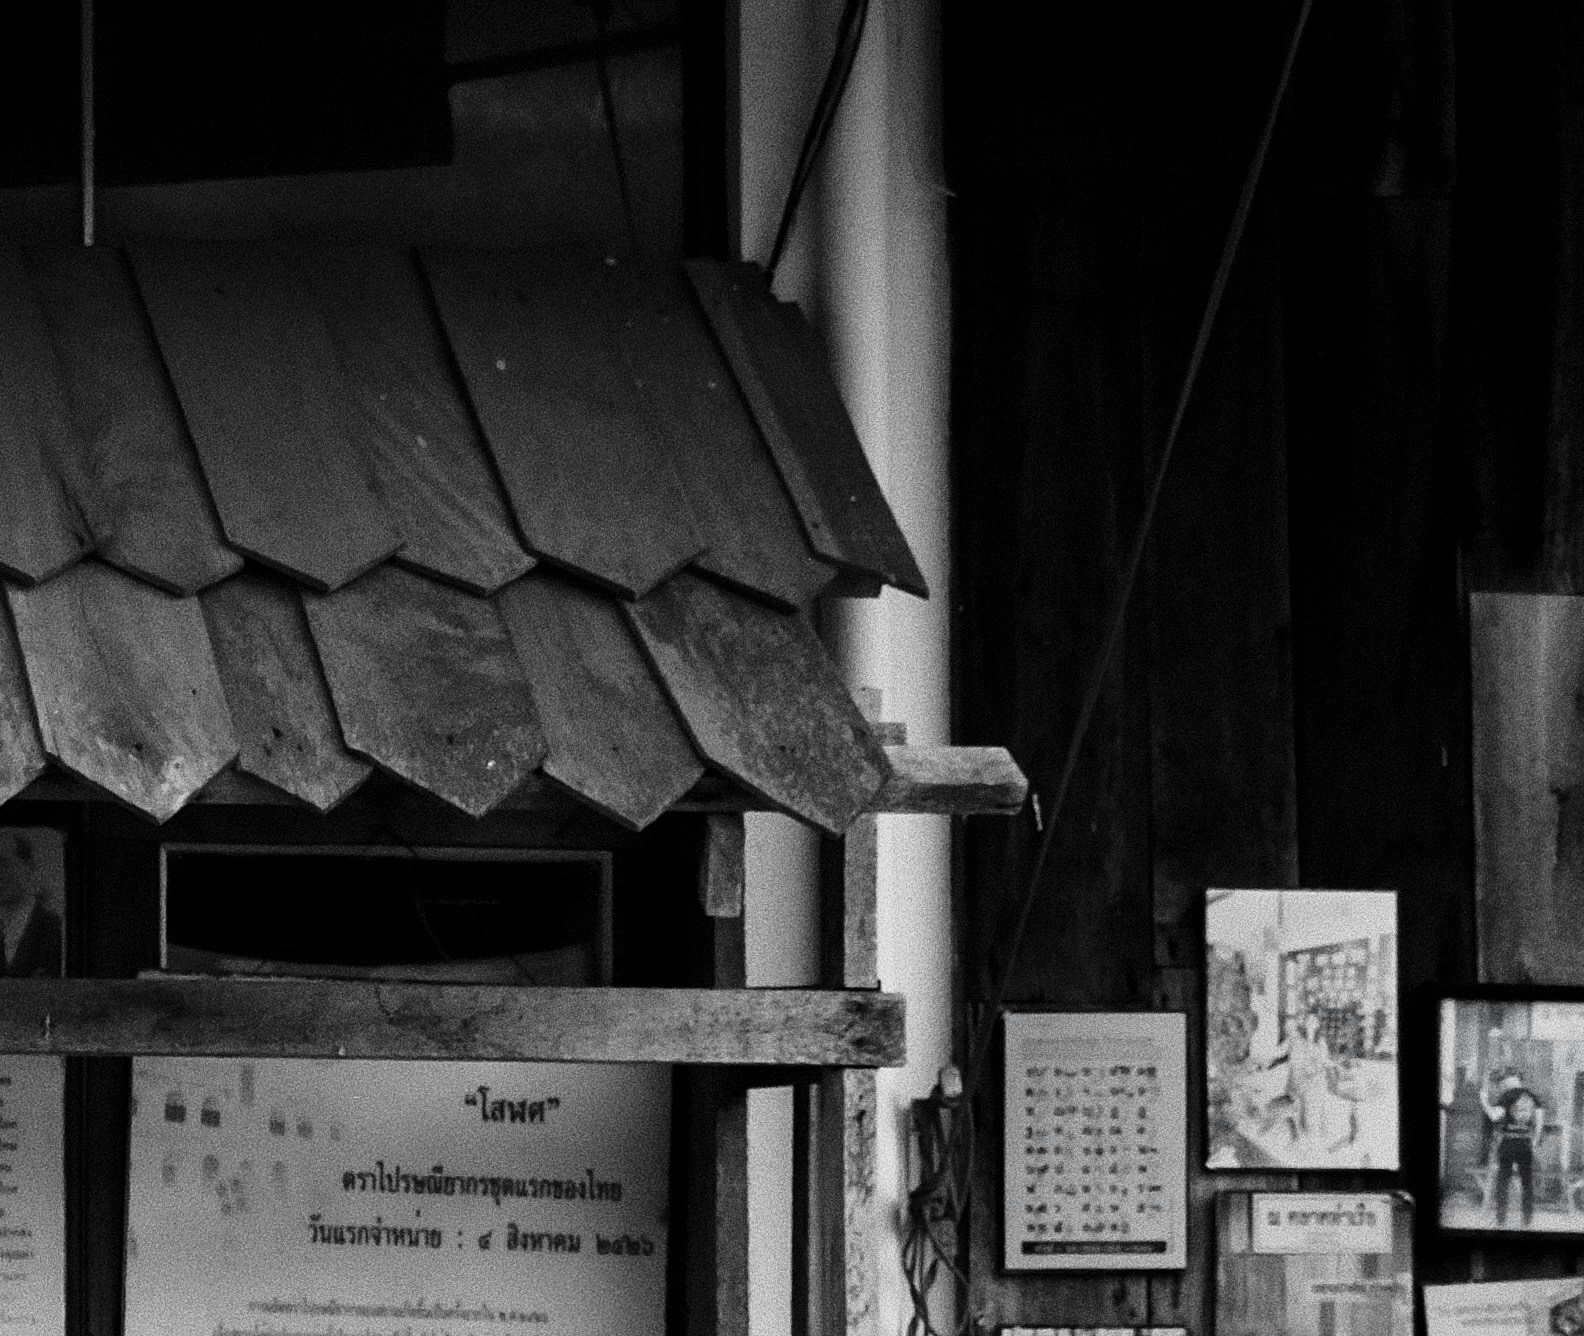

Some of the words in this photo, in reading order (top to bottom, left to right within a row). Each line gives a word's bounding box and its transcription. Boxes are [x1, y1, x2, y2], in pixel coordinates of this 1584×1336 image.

[307, 1209, 443, 1250] วันแรกจำหน่าย
[506, 1221, 582, 1254] สิงหาคม
